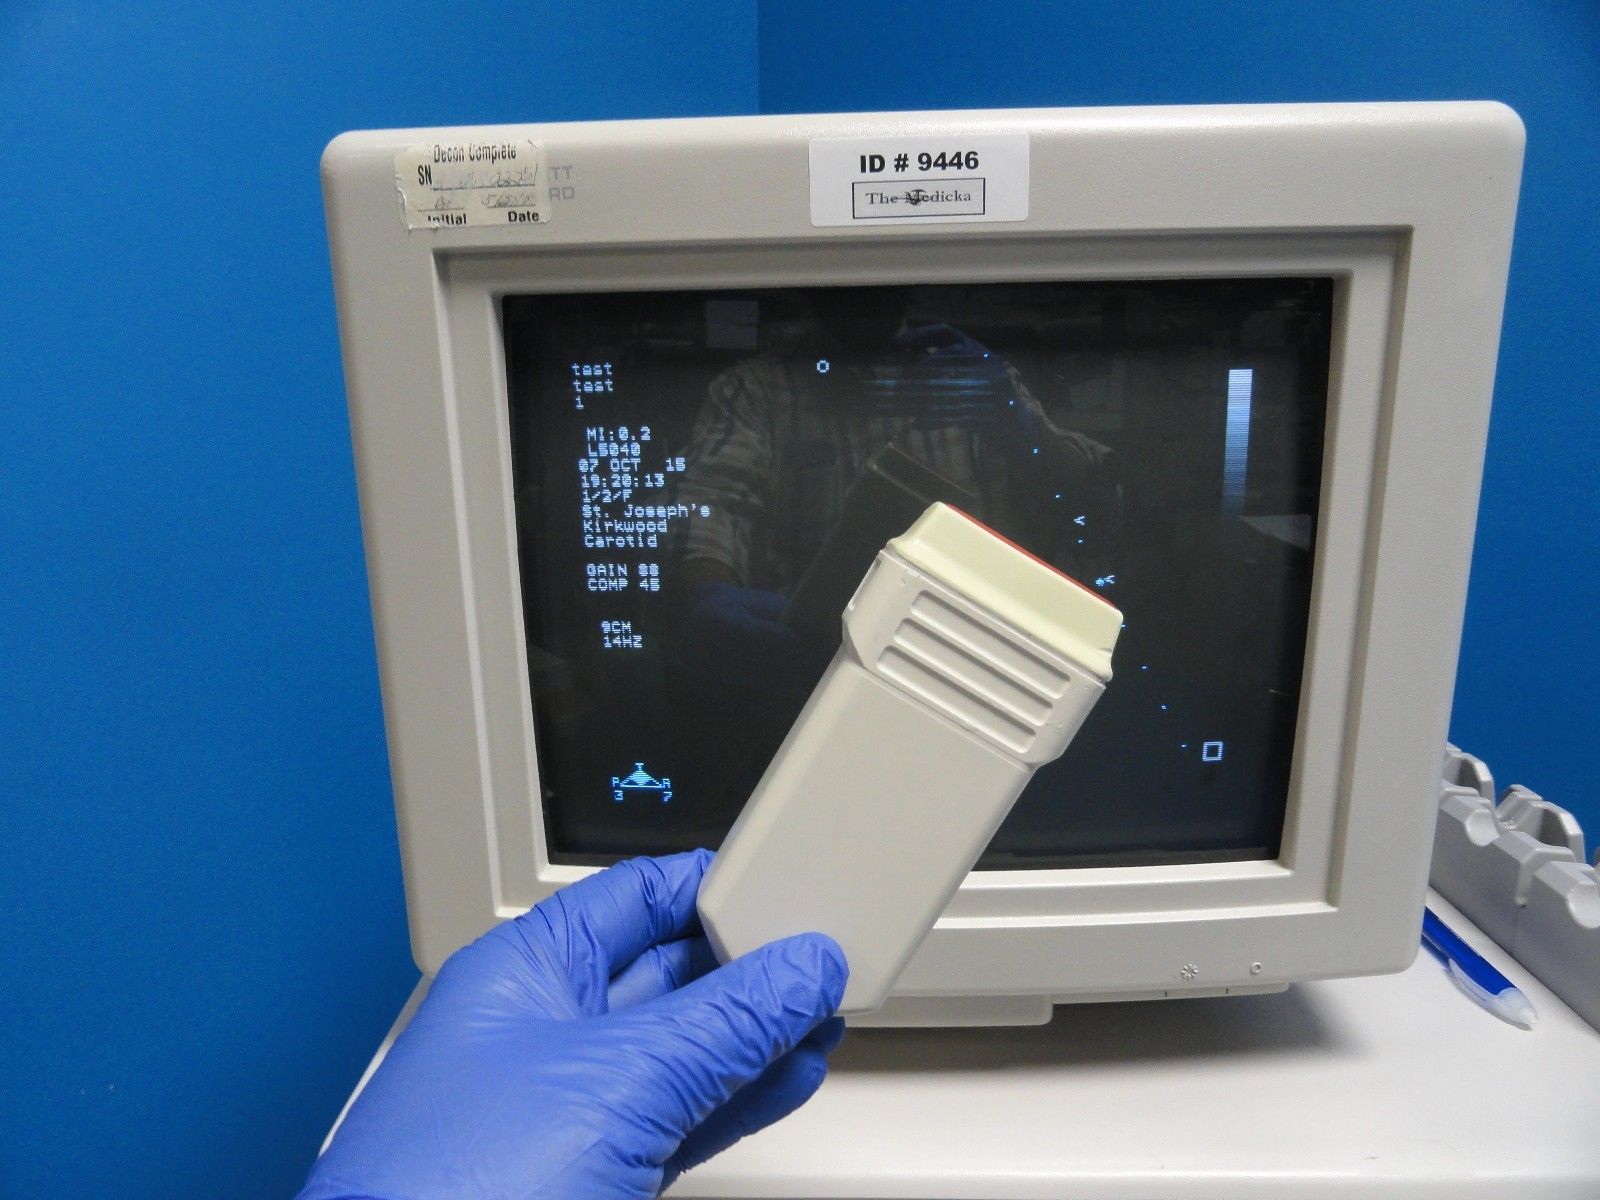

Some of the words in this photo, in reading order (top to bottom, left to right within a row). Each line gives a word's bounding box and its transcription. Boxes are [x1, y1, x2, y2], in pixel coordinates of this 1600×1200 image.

[860, 154, 886, 173] ID
[894, 153, 909, 172] #
[917, 151, 980, 172] 9446
[417, 165, 433, 186] SN
[865, 191, 899, 206] The
[904, 189, 972, 206] Medicka
[508, 211, 540, 223] Date
[571, 362, 613, 376] test
[572, 379, 614, 392] test
[578, 458, 599, 473] 07
[610, 457, 641, 472] OCT
[665, 456, 686, 472] 15
[582, 504, 610, 518] St.
[624, 503, 711, 519] Joseph's
[583, 516, 668, 533] Kirkwood
[584, 533, 658, 548] Carotid
[587, 563, 628, 577] GAIN
[588, 578, 629, 591] COMP
